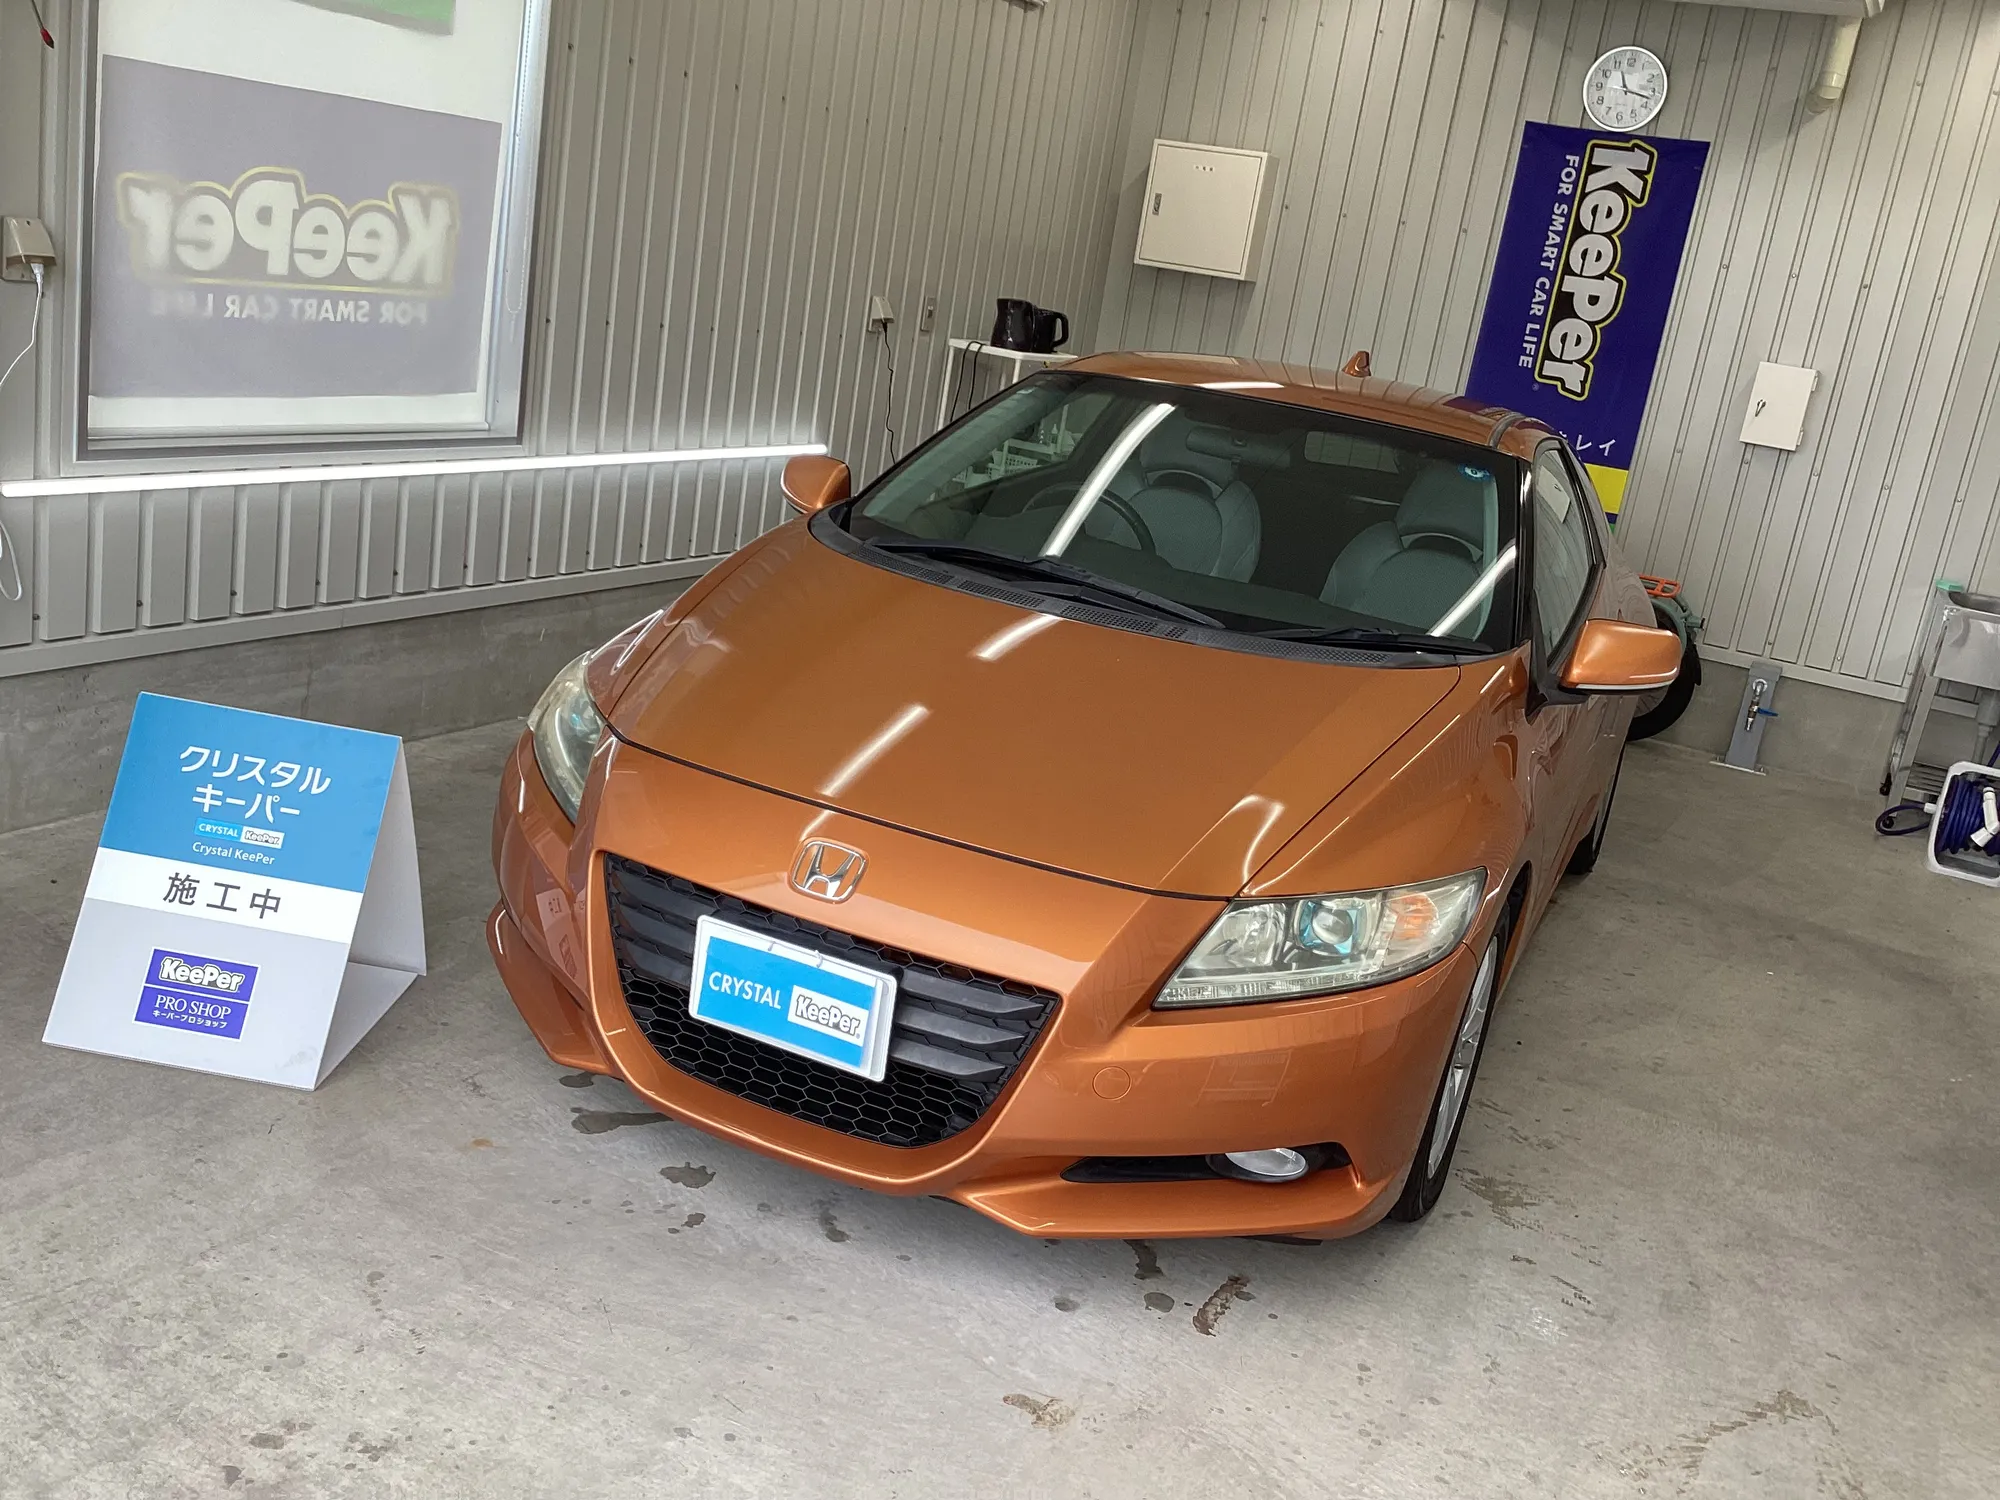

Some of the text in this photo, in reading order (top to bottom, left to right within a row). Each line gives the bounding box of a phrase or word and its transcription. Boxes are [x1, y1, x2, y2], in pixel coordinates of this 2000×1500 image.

[1518, 154, 1580, 369] FOR SMART CAR LIFE
[1540, 145, 1652, 395] KeePer
[180, 745, 332, 795] クリスタル
[192, 783, 301, 824] キーパー
[192, 841, 275, 865] Crystal KeePer
[198, 822, 280, 846] CRYSTAL KeePer
[163, 872, 281, 919] 施工中
[160, 957, 244, 992] KeePer
[152, 1009, 228, 1029] キーパープロショップ
[155, 994, 231, 1020] PRO SHOP
[708, 971, 860, 1036] CRYSTAL KeePer
